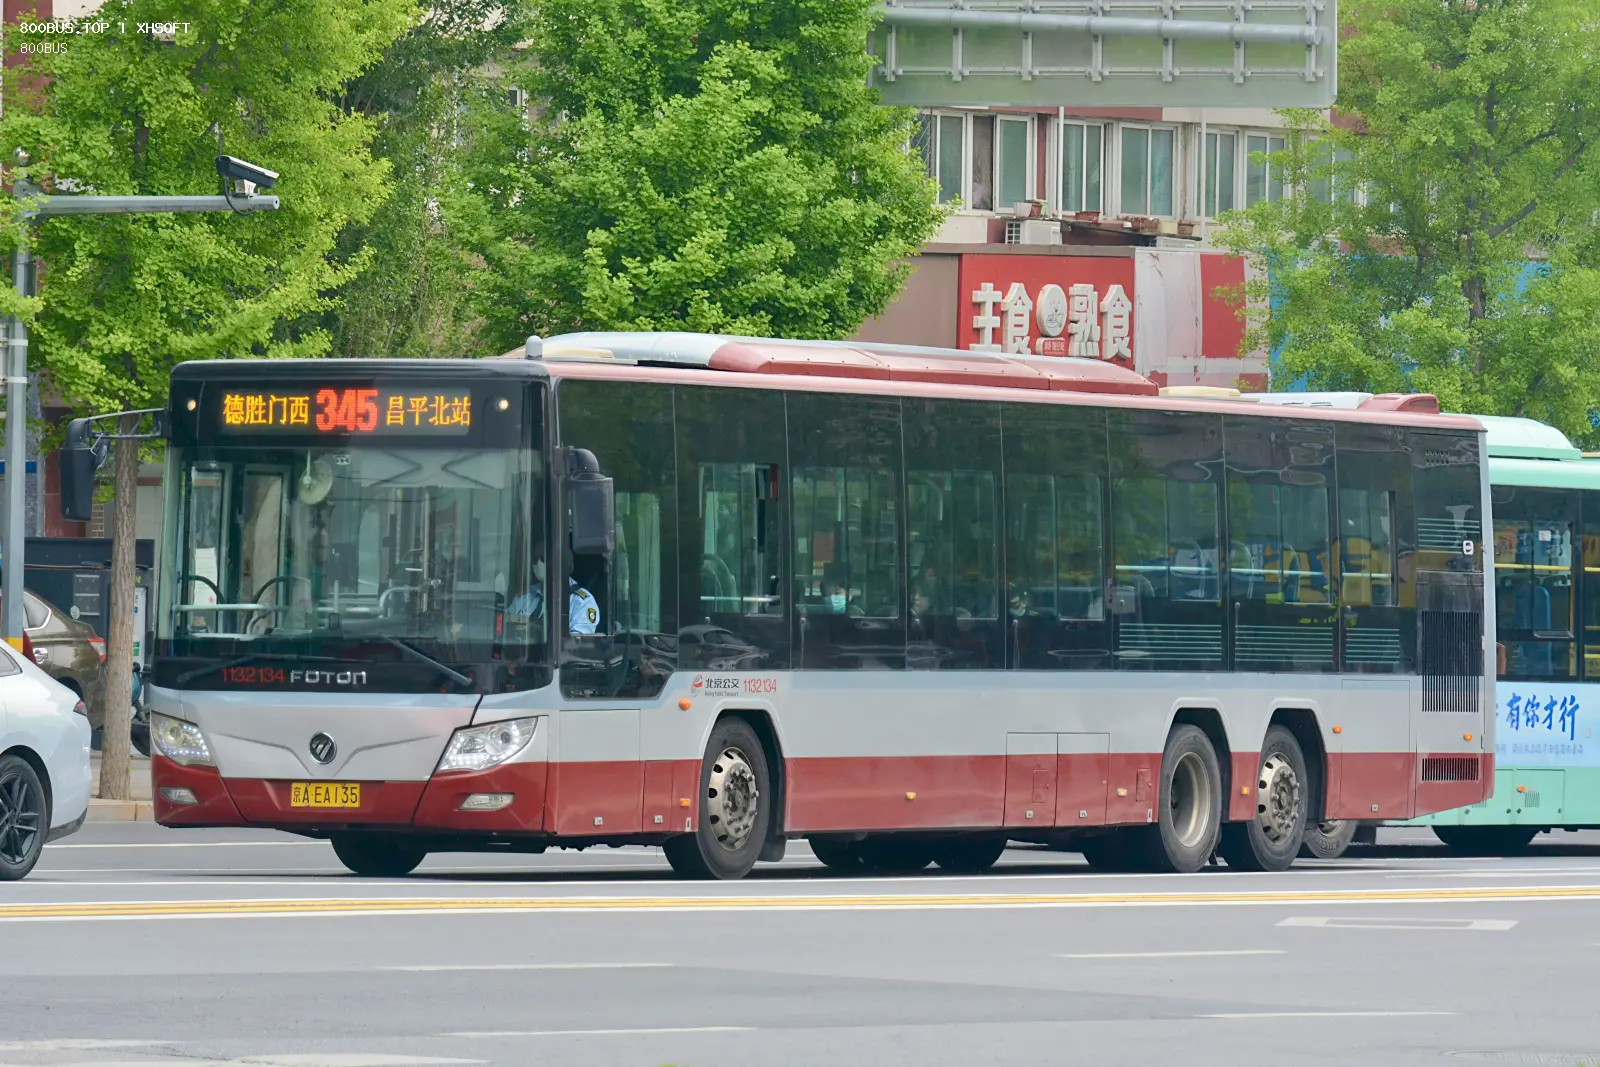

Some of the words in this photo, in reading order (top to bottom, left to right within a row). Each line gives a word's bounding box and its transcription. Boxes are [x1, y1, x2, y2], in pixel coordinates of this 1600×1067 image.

[970, 282, 1033, 355] 主食
[1068, 284, 1132, 360] 熟食
[223, 394, 310, 425] 德胜门西
[315, 388, 379, 432] 345
[386, 395, 471, 426] 昌平北站
[222, 667, 285, 683] 1132134
[705, 679, 740, 689] 北京公交
[743, 678, 777, 693] 1132134
[1496, 692, 1580, 741] 有你才行
